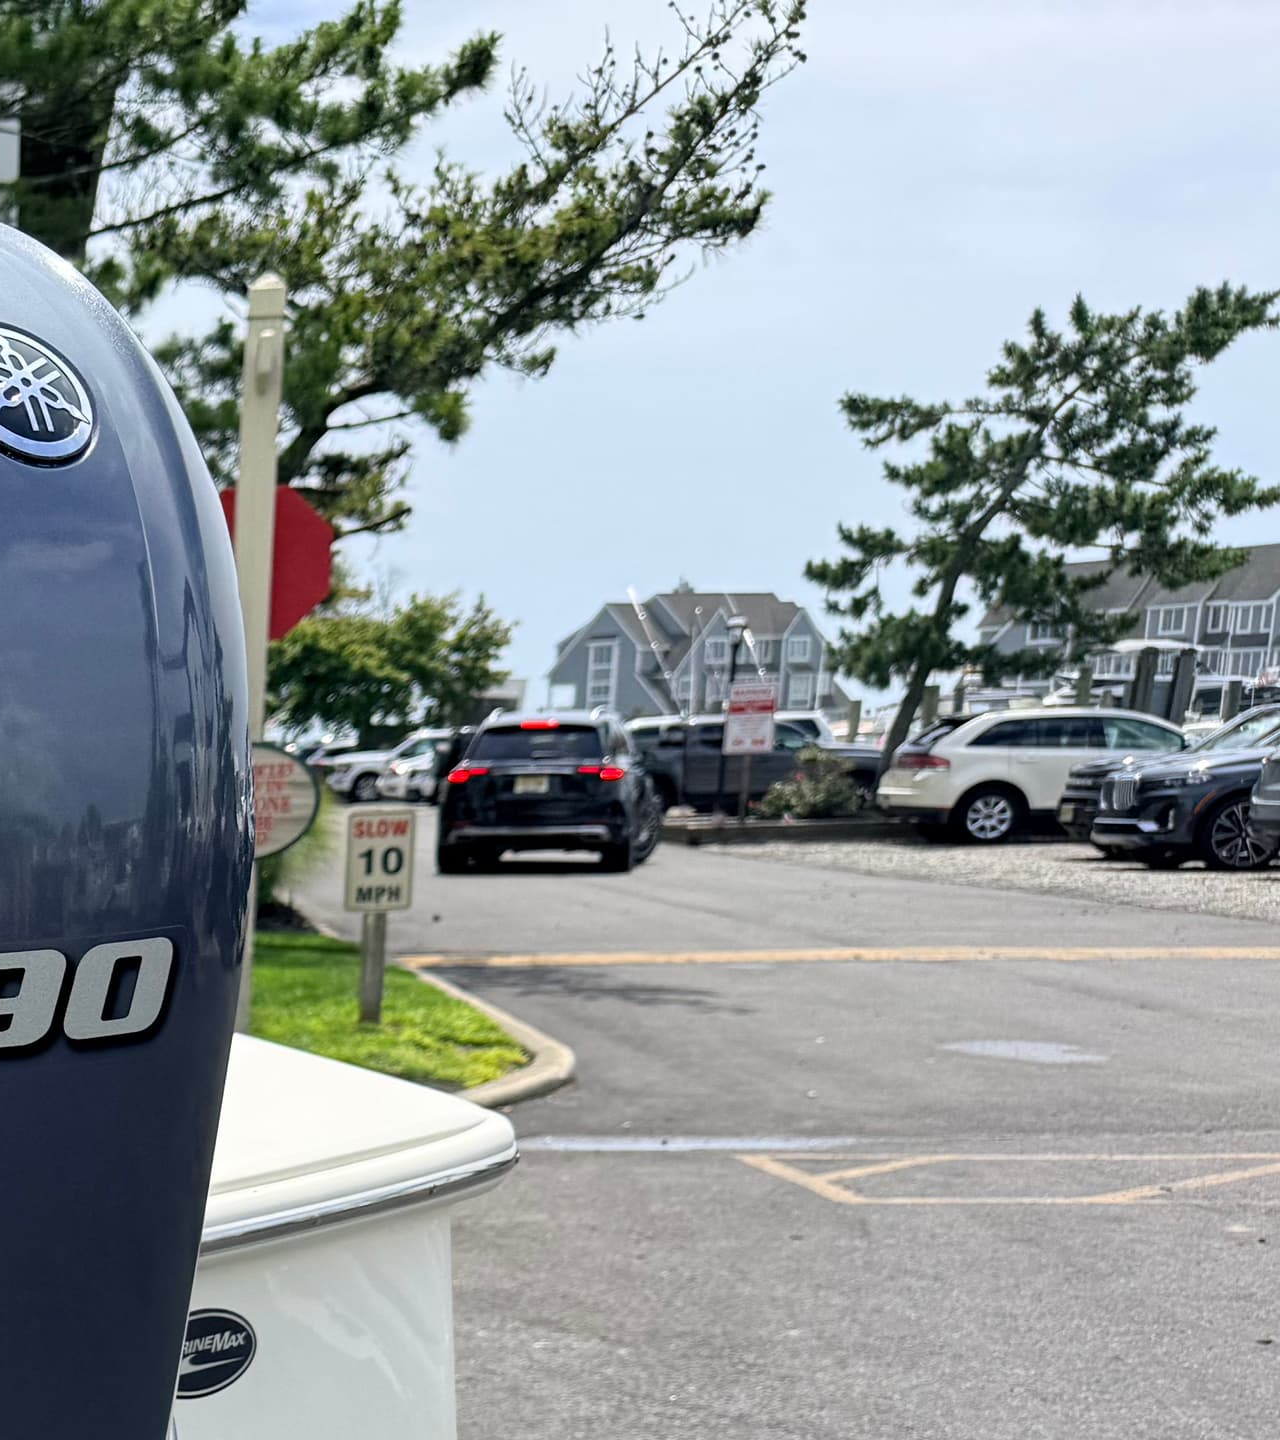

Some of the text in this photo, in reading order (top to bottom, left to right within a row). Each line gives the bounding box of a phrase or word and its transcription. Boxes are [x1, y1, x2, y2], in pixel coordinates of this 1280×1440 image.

[354, 820, 409, 838] SLOW
[359, 848, 404, 876] 10
[356, 887, 401, 904] MPH
